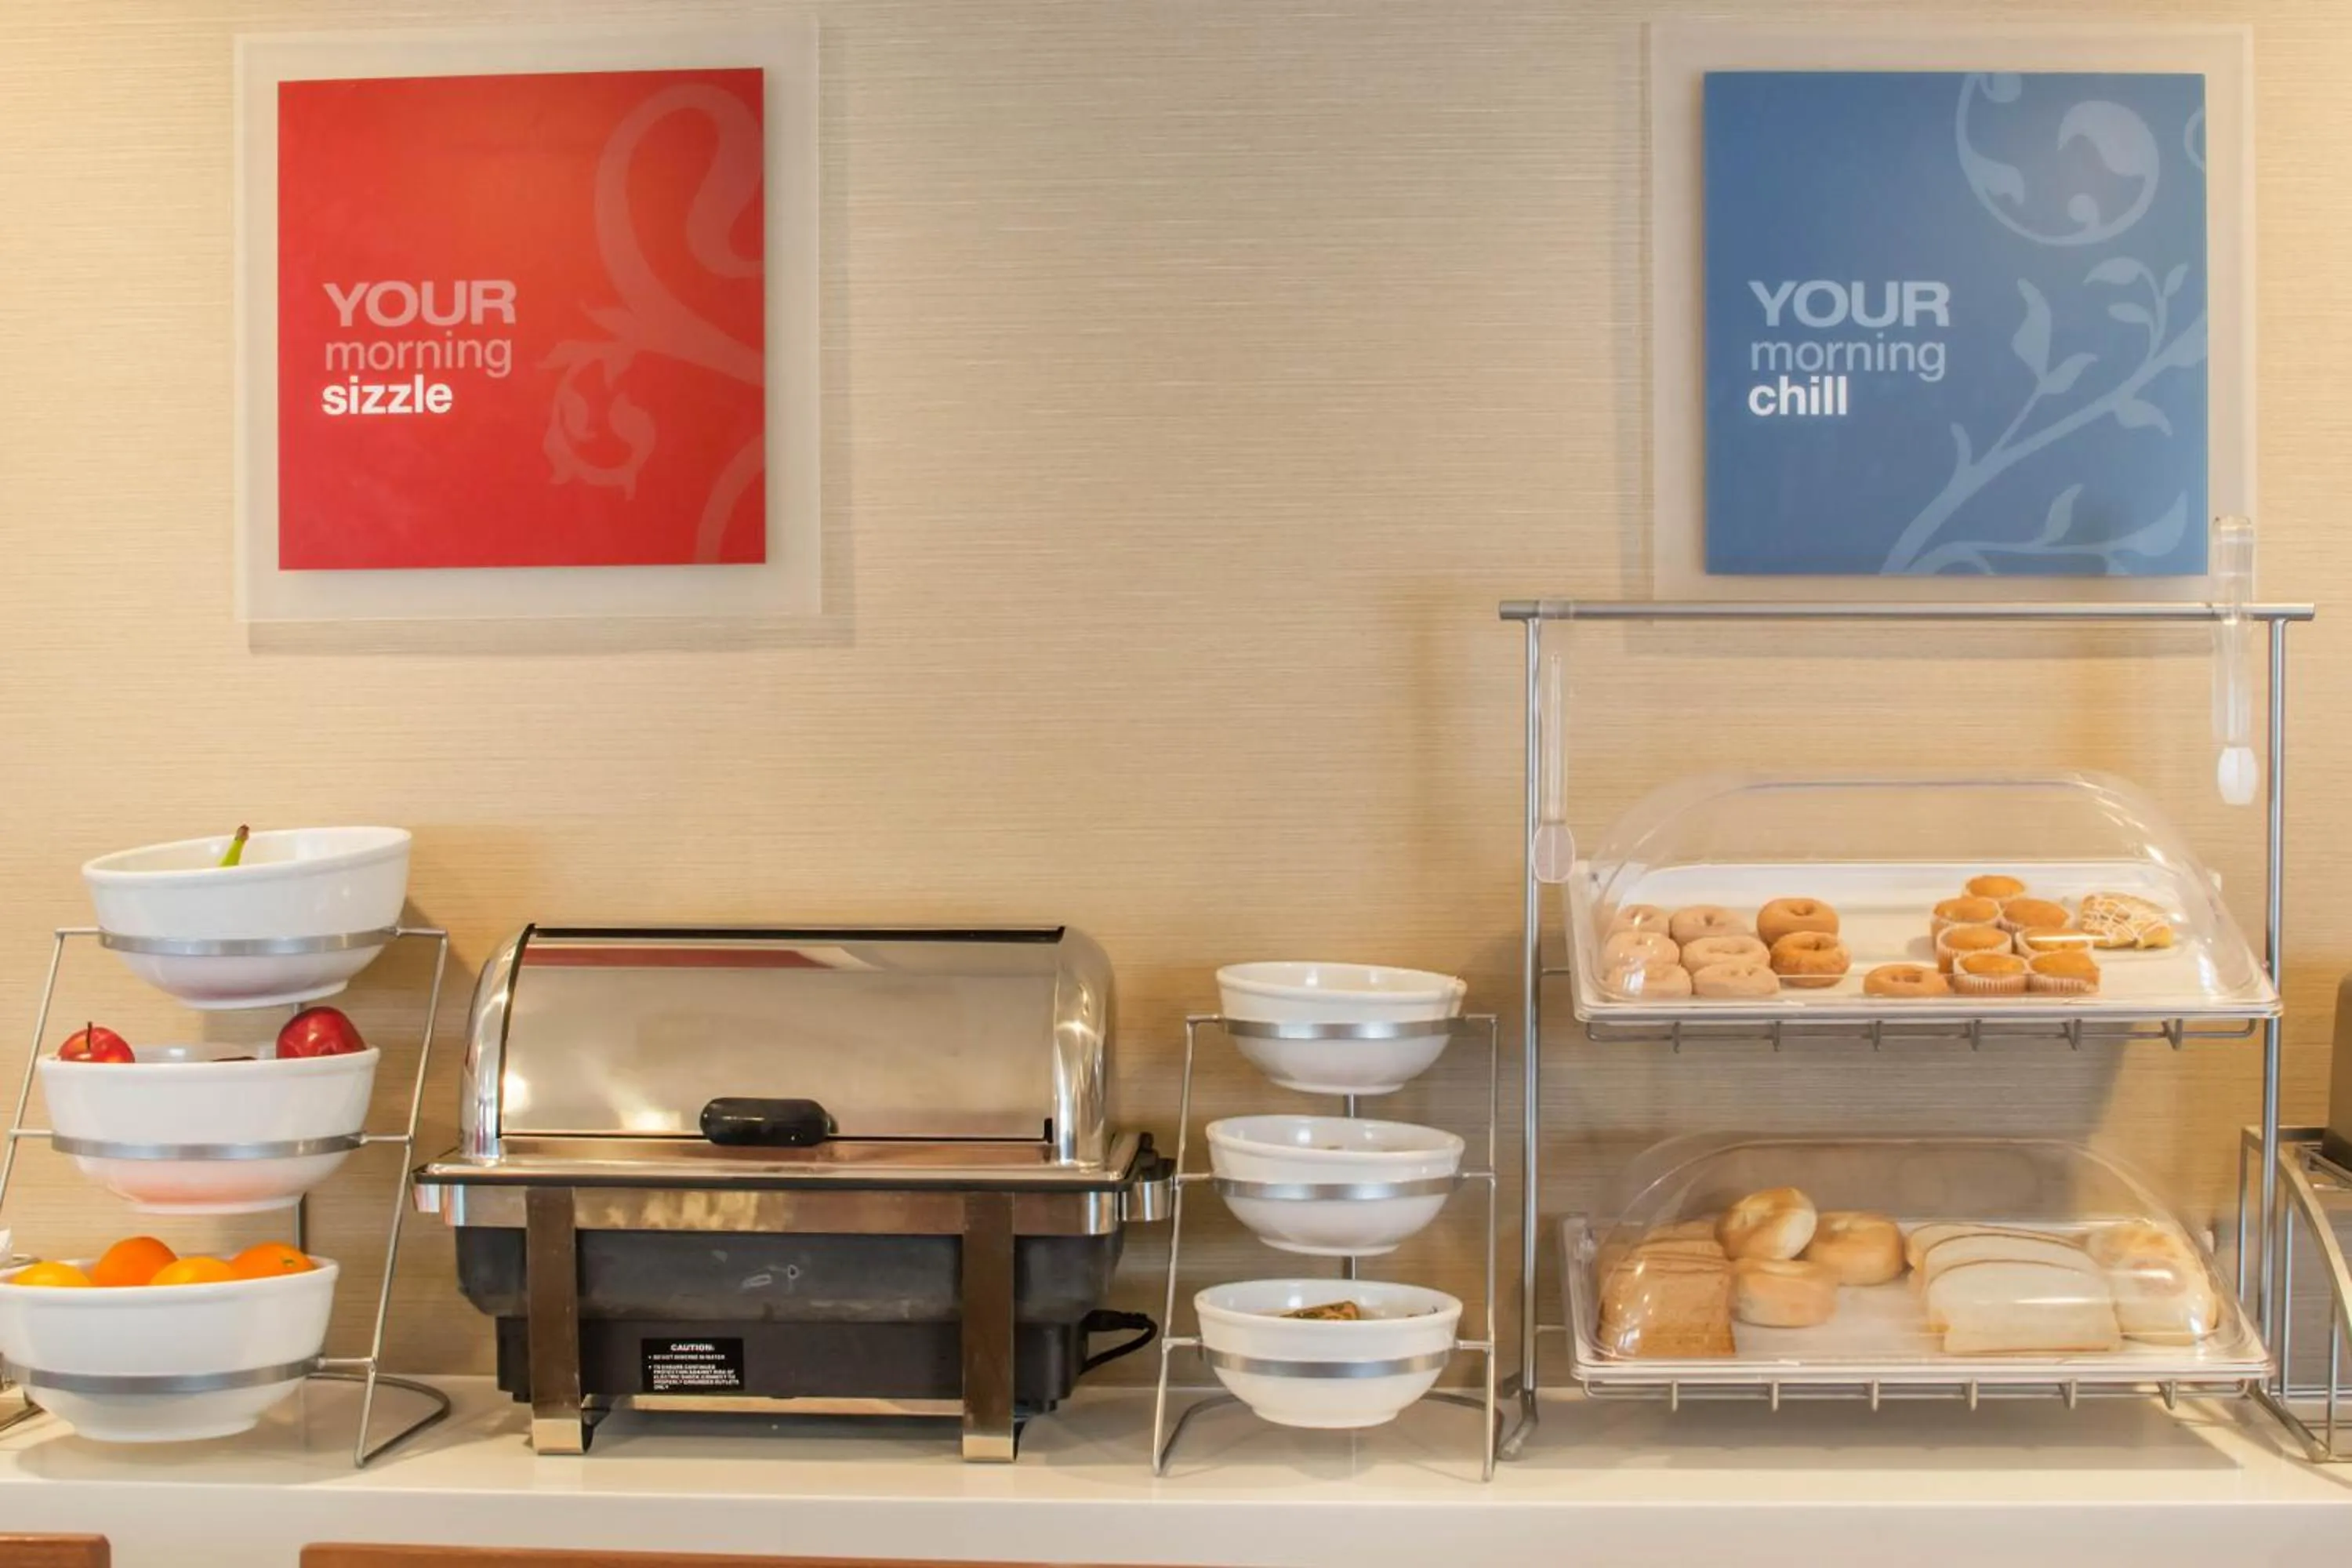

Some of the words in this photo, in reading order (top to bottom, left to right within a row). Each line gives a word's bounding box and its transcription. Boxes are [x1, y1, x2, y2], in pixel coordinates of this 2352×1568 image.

[324, 280, 517, 327] YOUR
[1749, 281, 1950, 327] YOUR
[325, 331, 512, 378] morning
[1751, 332, 1946, 382] morning
[321, 374, 454, 416] sizzle
[1748, 376, 1848, 416] chill
